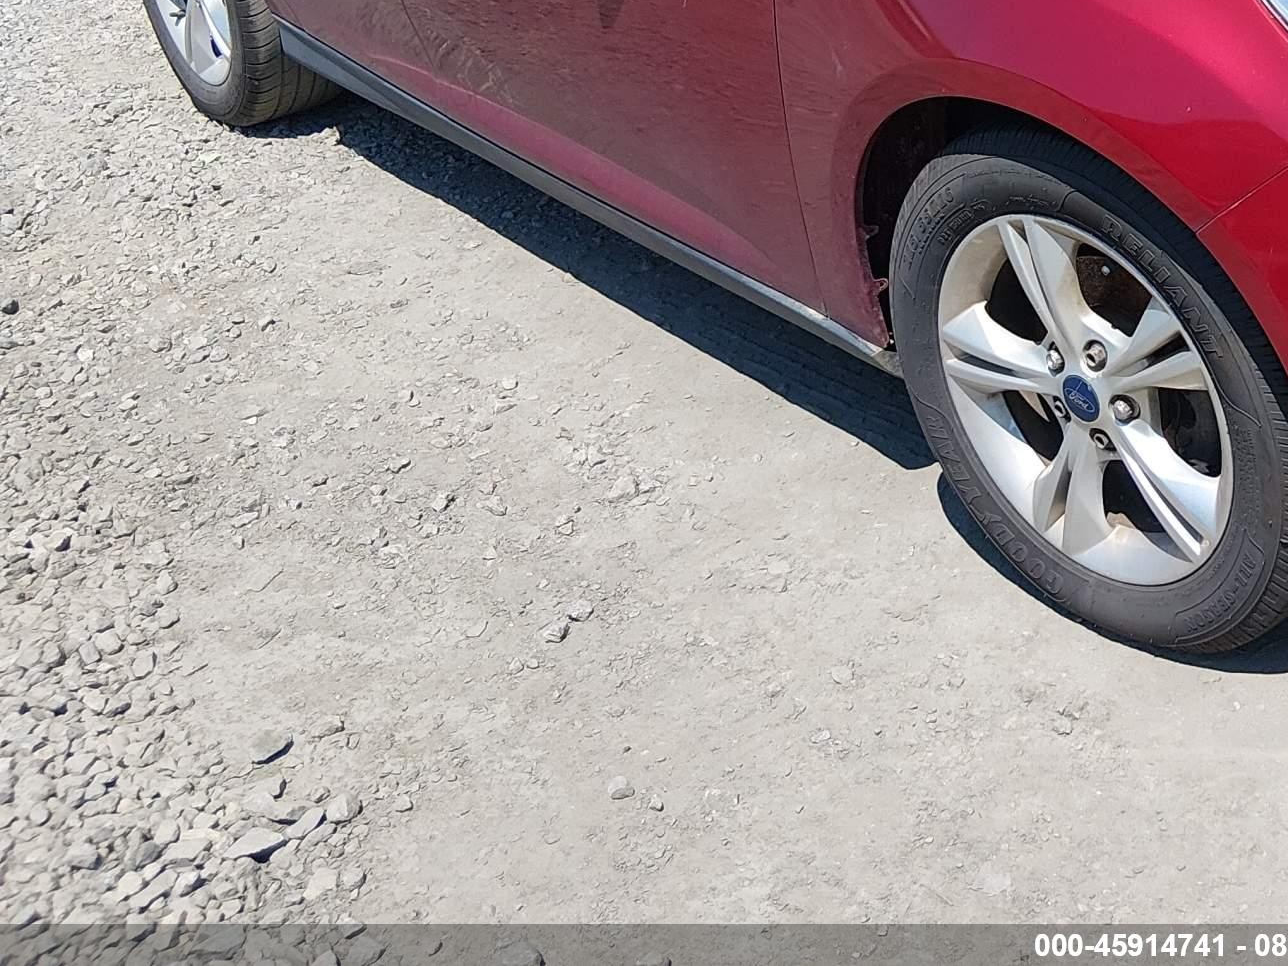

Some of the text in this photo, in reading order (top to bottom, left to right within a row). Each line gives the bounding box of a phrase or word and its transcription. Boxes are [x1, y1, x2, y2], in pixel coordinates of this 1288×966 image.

[1101, 213, 1224, 359] RELIANT
[1067, 390, 1091, 409] Ford
[925, 415, 1065, 596] GOODYEAR
